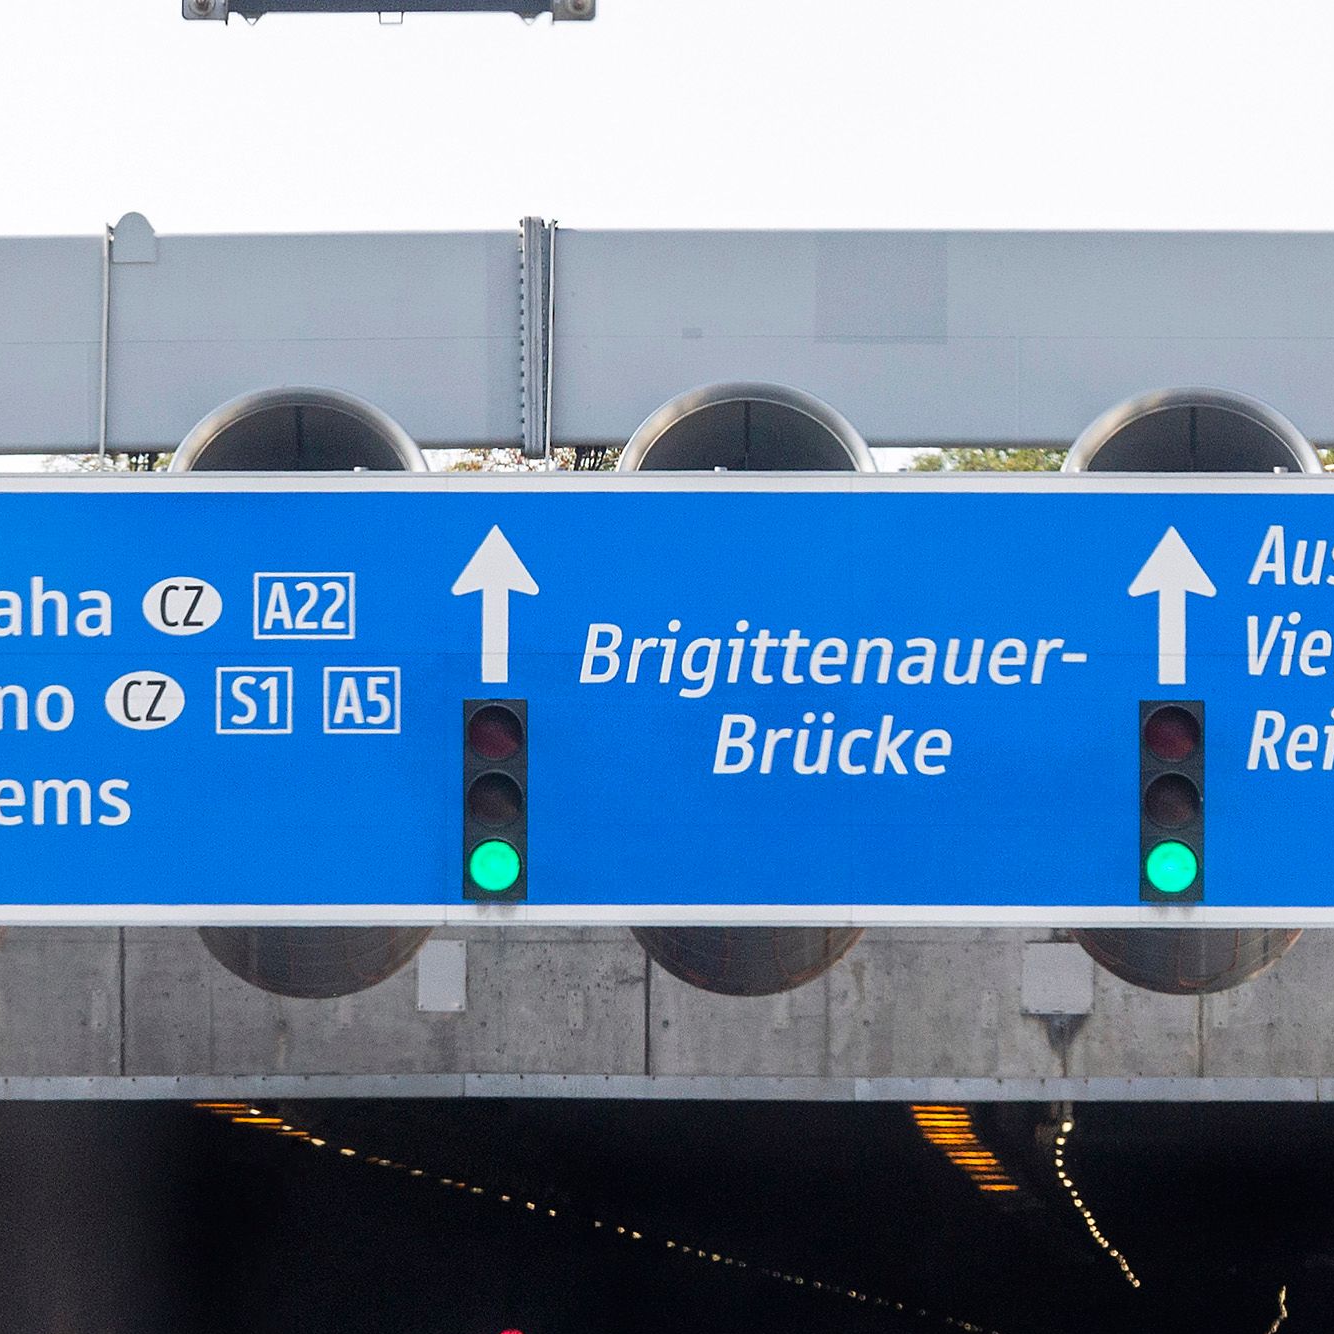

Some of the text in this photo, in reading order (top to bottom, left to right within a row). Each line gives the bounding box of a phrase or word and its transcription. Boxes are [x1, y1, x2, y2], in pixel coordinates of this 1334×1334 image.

[159, 584, 204, 628] CZ
[263, 580, 347, 631] A22
[579, 619, 1088, 699] Brigittenauer-
[122, 679, 168, 723] CZ
[230, 674, 279, 725] S1
[333, 675, 392, 725] A5
[712, 711, 953, 776] Brücke
